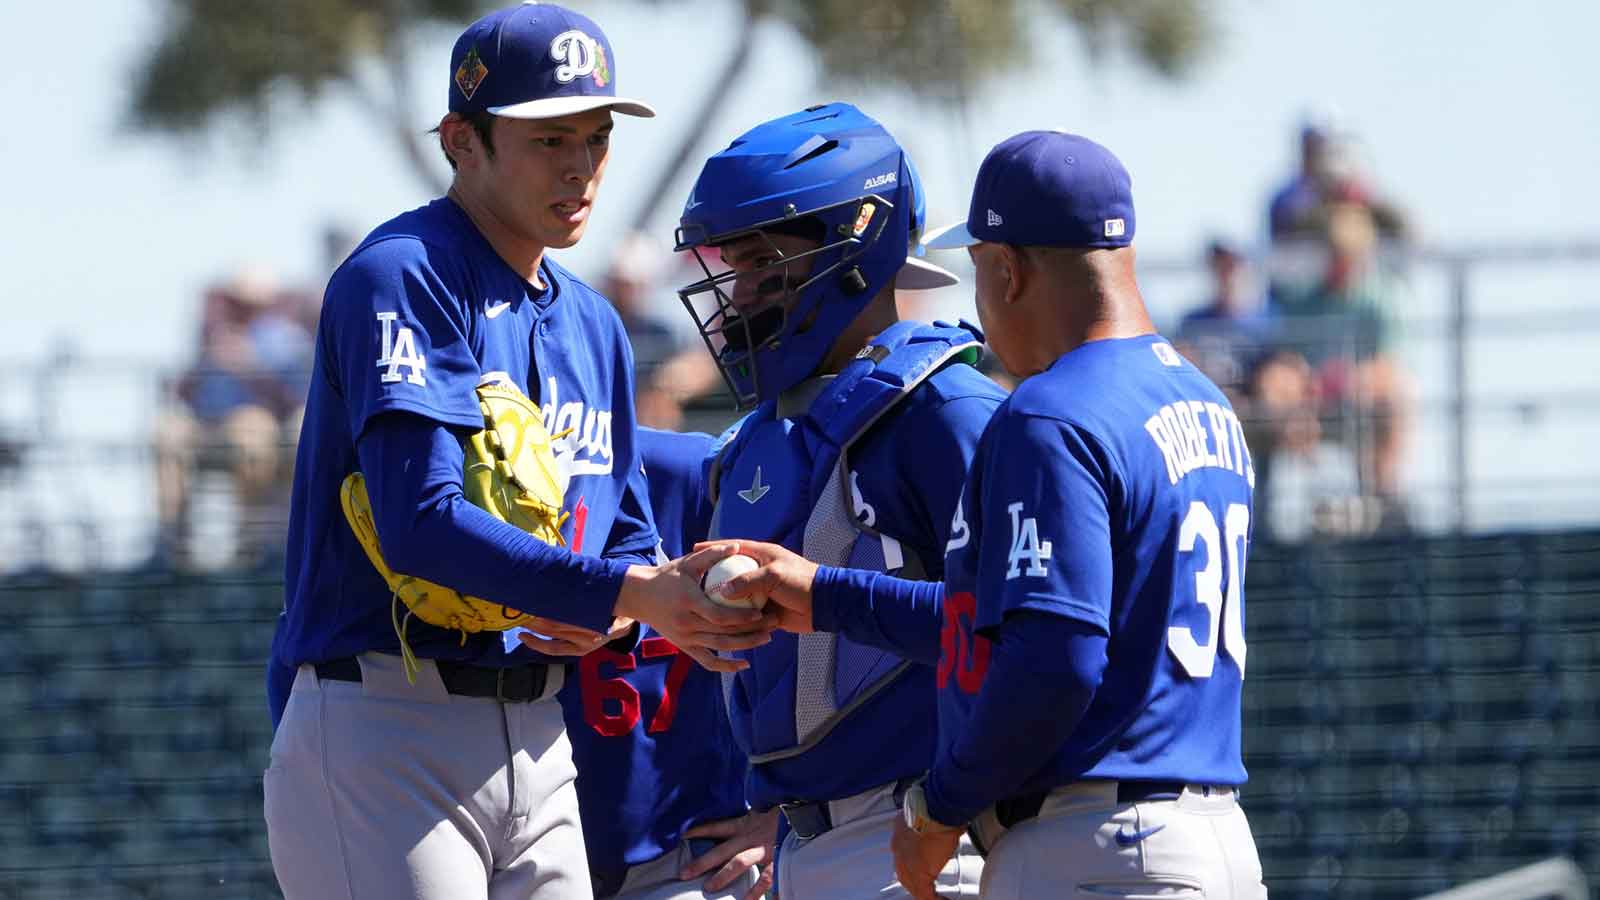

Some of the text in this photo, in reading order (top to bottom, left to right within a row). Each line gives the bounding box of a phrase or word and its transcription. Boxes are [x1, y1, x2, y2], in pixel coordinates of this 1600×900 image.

[551, 30, 596, 84] D
[376, 311, 426, 388] LA
[1006, 502, 1052, 580] LA
[1168, 501, 1249, 680] 30
[580, 637, 692, 737] 67
